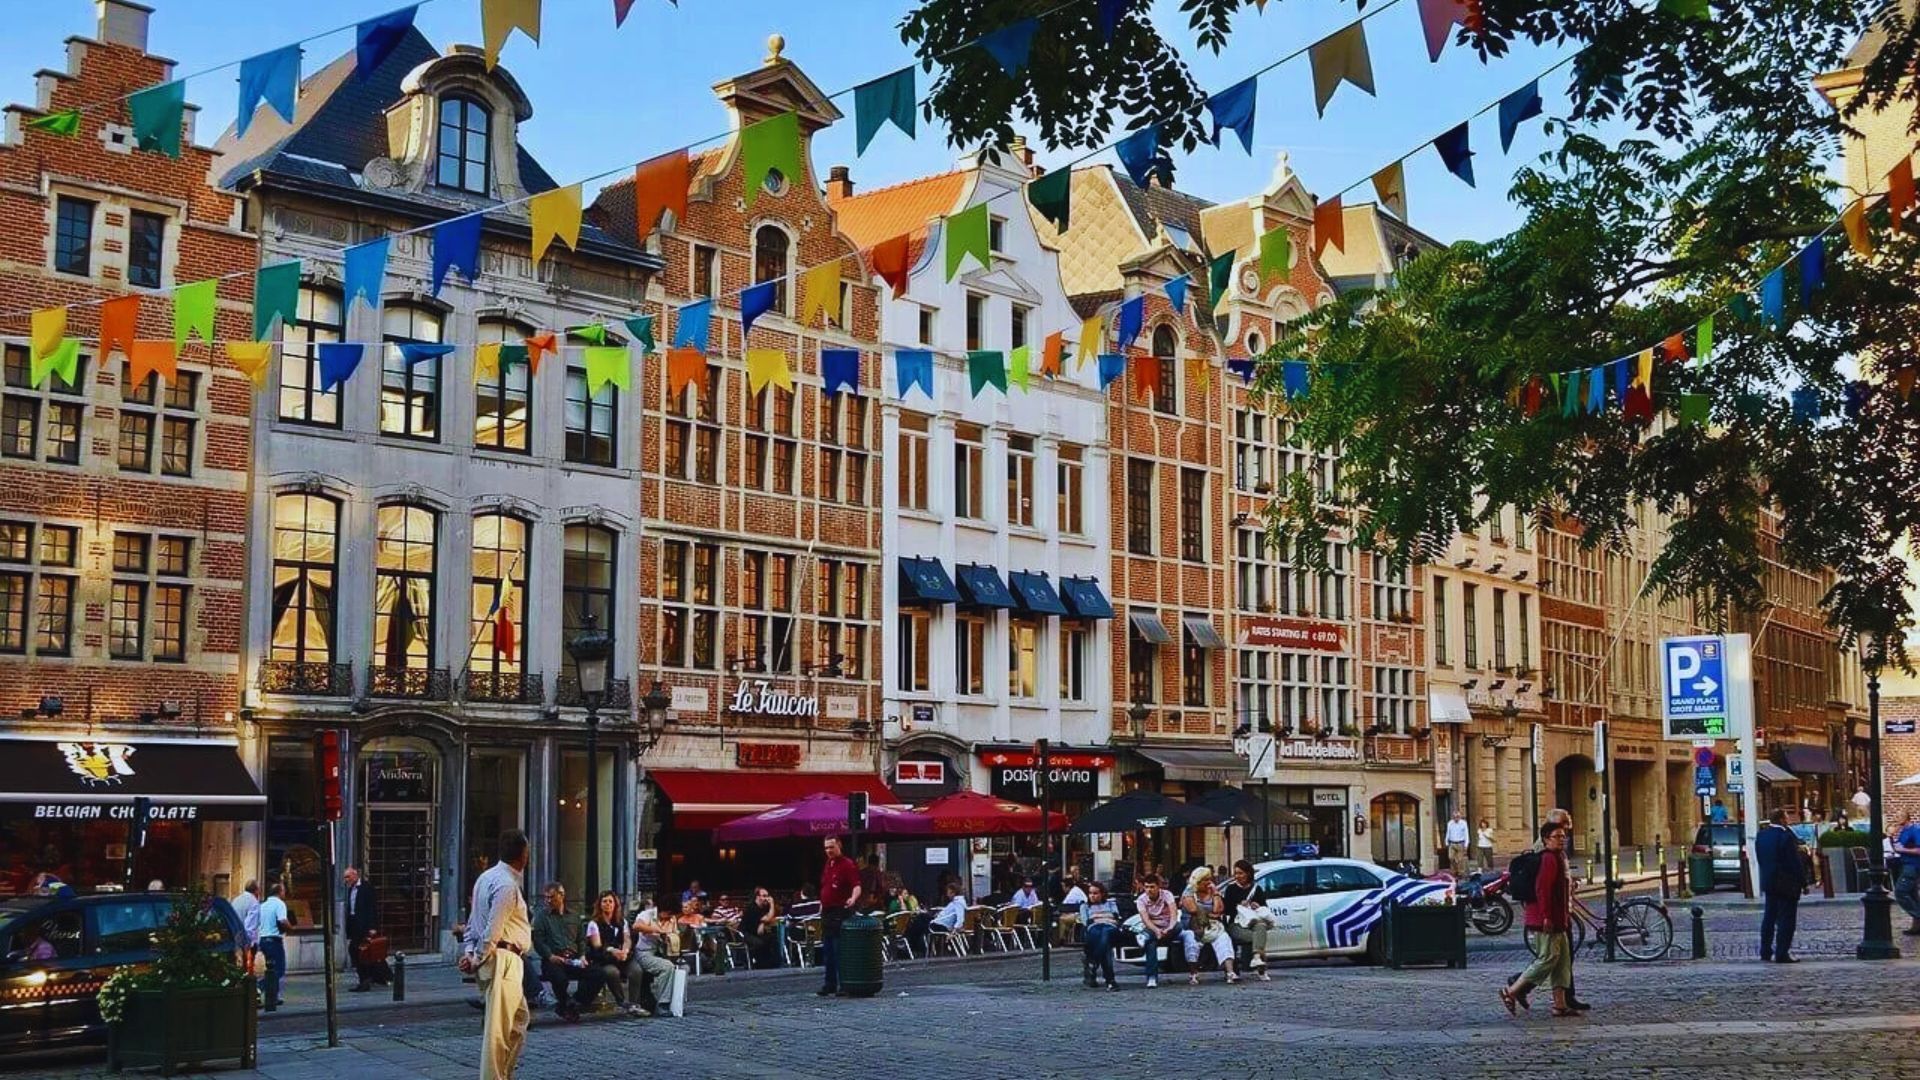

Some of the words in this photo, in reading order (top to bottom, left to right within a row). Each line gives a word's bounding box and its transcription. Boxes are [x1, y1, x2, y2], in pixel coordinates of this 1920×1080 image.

[1271, 627, 1301, 639] STARTING
[1669, 646, 1701, 696] P
[729, 679, 753, 712] Le
[753, 680, 820, 716] Faucon
[1696, 697, 1719, 705] PLACE
[1294, 741, 1356, 758] Madeleine
[378, 768, 422, 780] Andorra
[1003, 768, 1041, 786] past
[1048, 769, 1091, 783] divina
[1316, 793, 1341, 801] HOTEL
[35, 805, 101, 819] BELGIAN
[109, 805, 197, 820] CHOLATE
